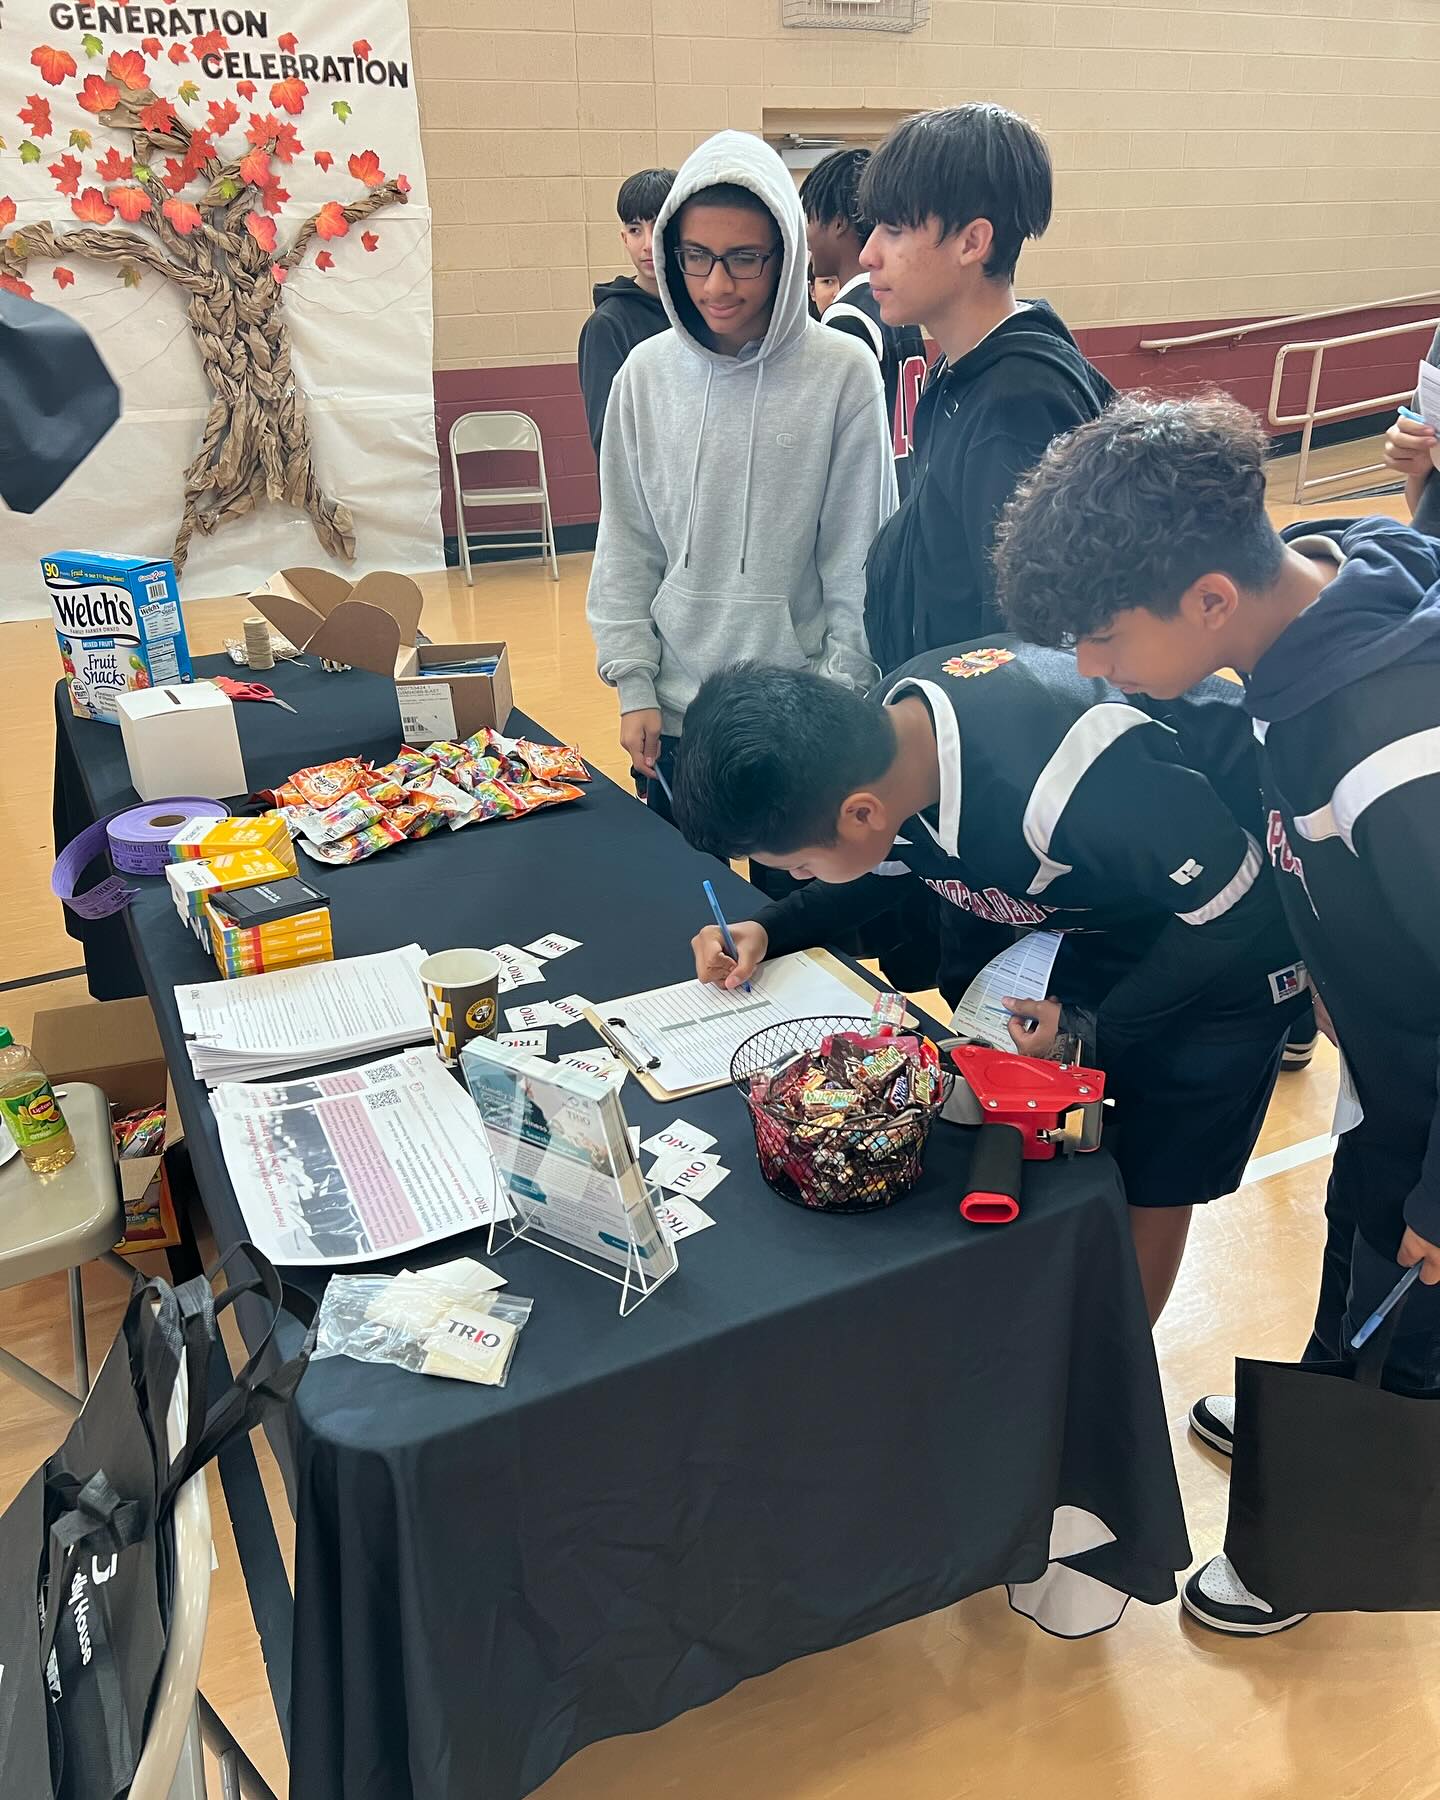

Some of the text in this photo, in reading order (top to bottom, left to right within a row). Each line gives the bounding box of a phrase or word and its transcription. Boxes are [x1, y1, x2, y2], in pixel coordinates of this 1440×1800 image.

[50, 3, 268, 38] GENERATION
[202, 51, 409, 88] CELEBRATION
[44, 562, 59, 577] 90
[51, 592, 133, 627] Welch's
[88, 654, 117, 671] Fruit
[83, 666, 126, 686] Snacks
[125, 843, 144, 853] TICKET
[154, 844, 170, 854] TICK
[95, 881, 115, 896] TICKET
[541, 939, 569, 952] TRIO
[508, 965, 525, 984] TRIO
[520, 1007, 537, 1027] TRIO
[554, 1001, 584, 1019] TRIO
[565, 1059, 600, 1073] TRIO
[32, 1101, 52, 1114] Lipton
[671, 1161, 706, 1187] TRIO
[448, 1319, 501, 1348] TRIO
[74, 1597, 92, 1666] House
